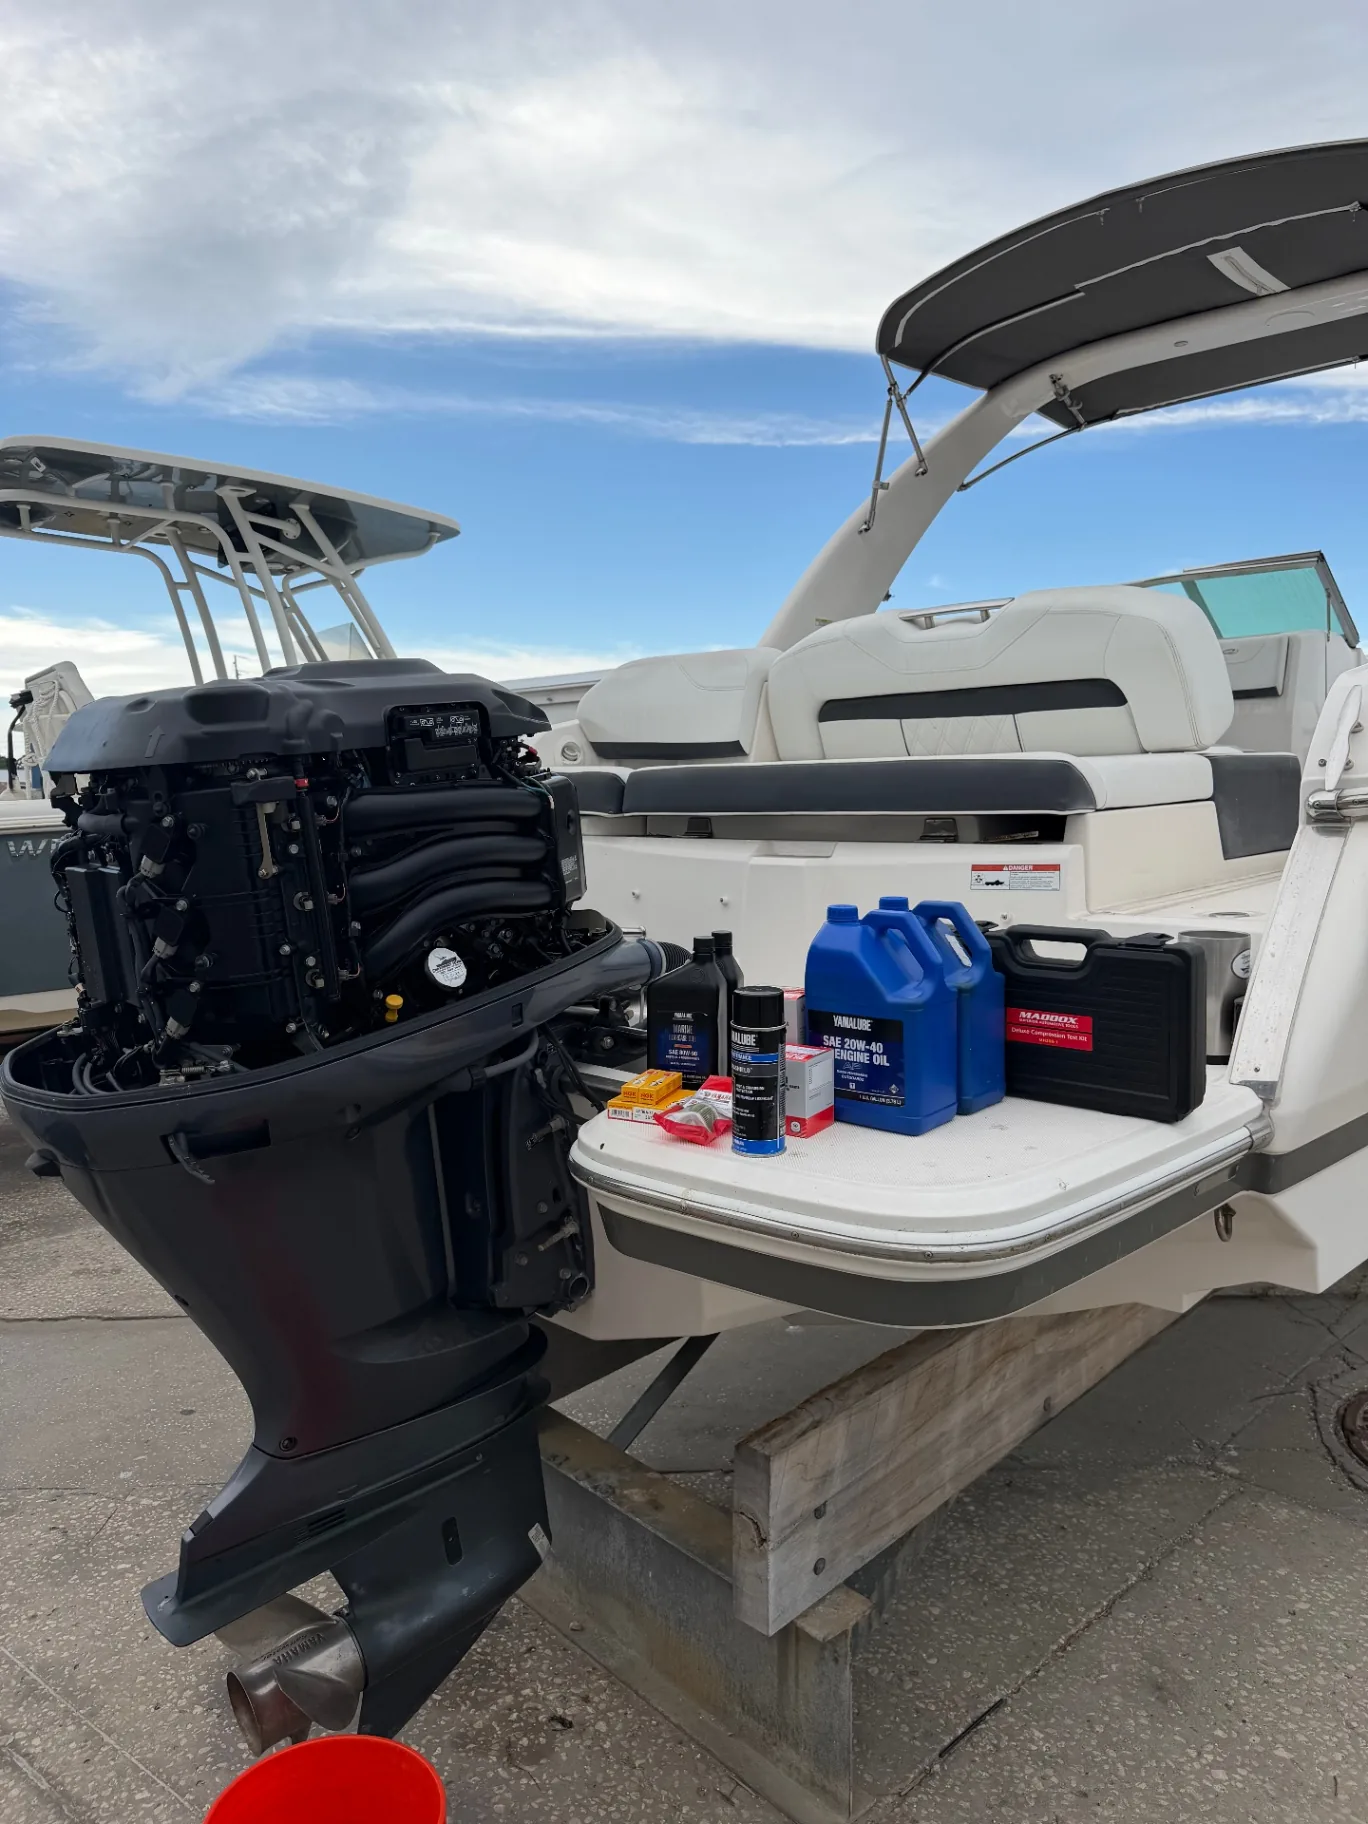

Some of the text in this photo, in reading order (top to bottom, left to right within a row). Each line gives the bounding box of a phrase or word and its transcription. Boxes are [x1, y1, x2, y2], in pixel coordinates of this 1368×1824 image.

[833, 1015, 872, 1031] YAMALUBE
[1019, 1011, 1079, 1025] MADDOX
[1011, 1027, 1030, 1035] Deluxe
[1030, 1029, 1066, 1040] Compression
[823, 1035, 884, 1054] SAE 20W-40
[834, 1049, 870, 1064] ENGINE
[873, 1053, 891, 1066] OIL
[272, 1633, 327, 1666] YAMAHA
